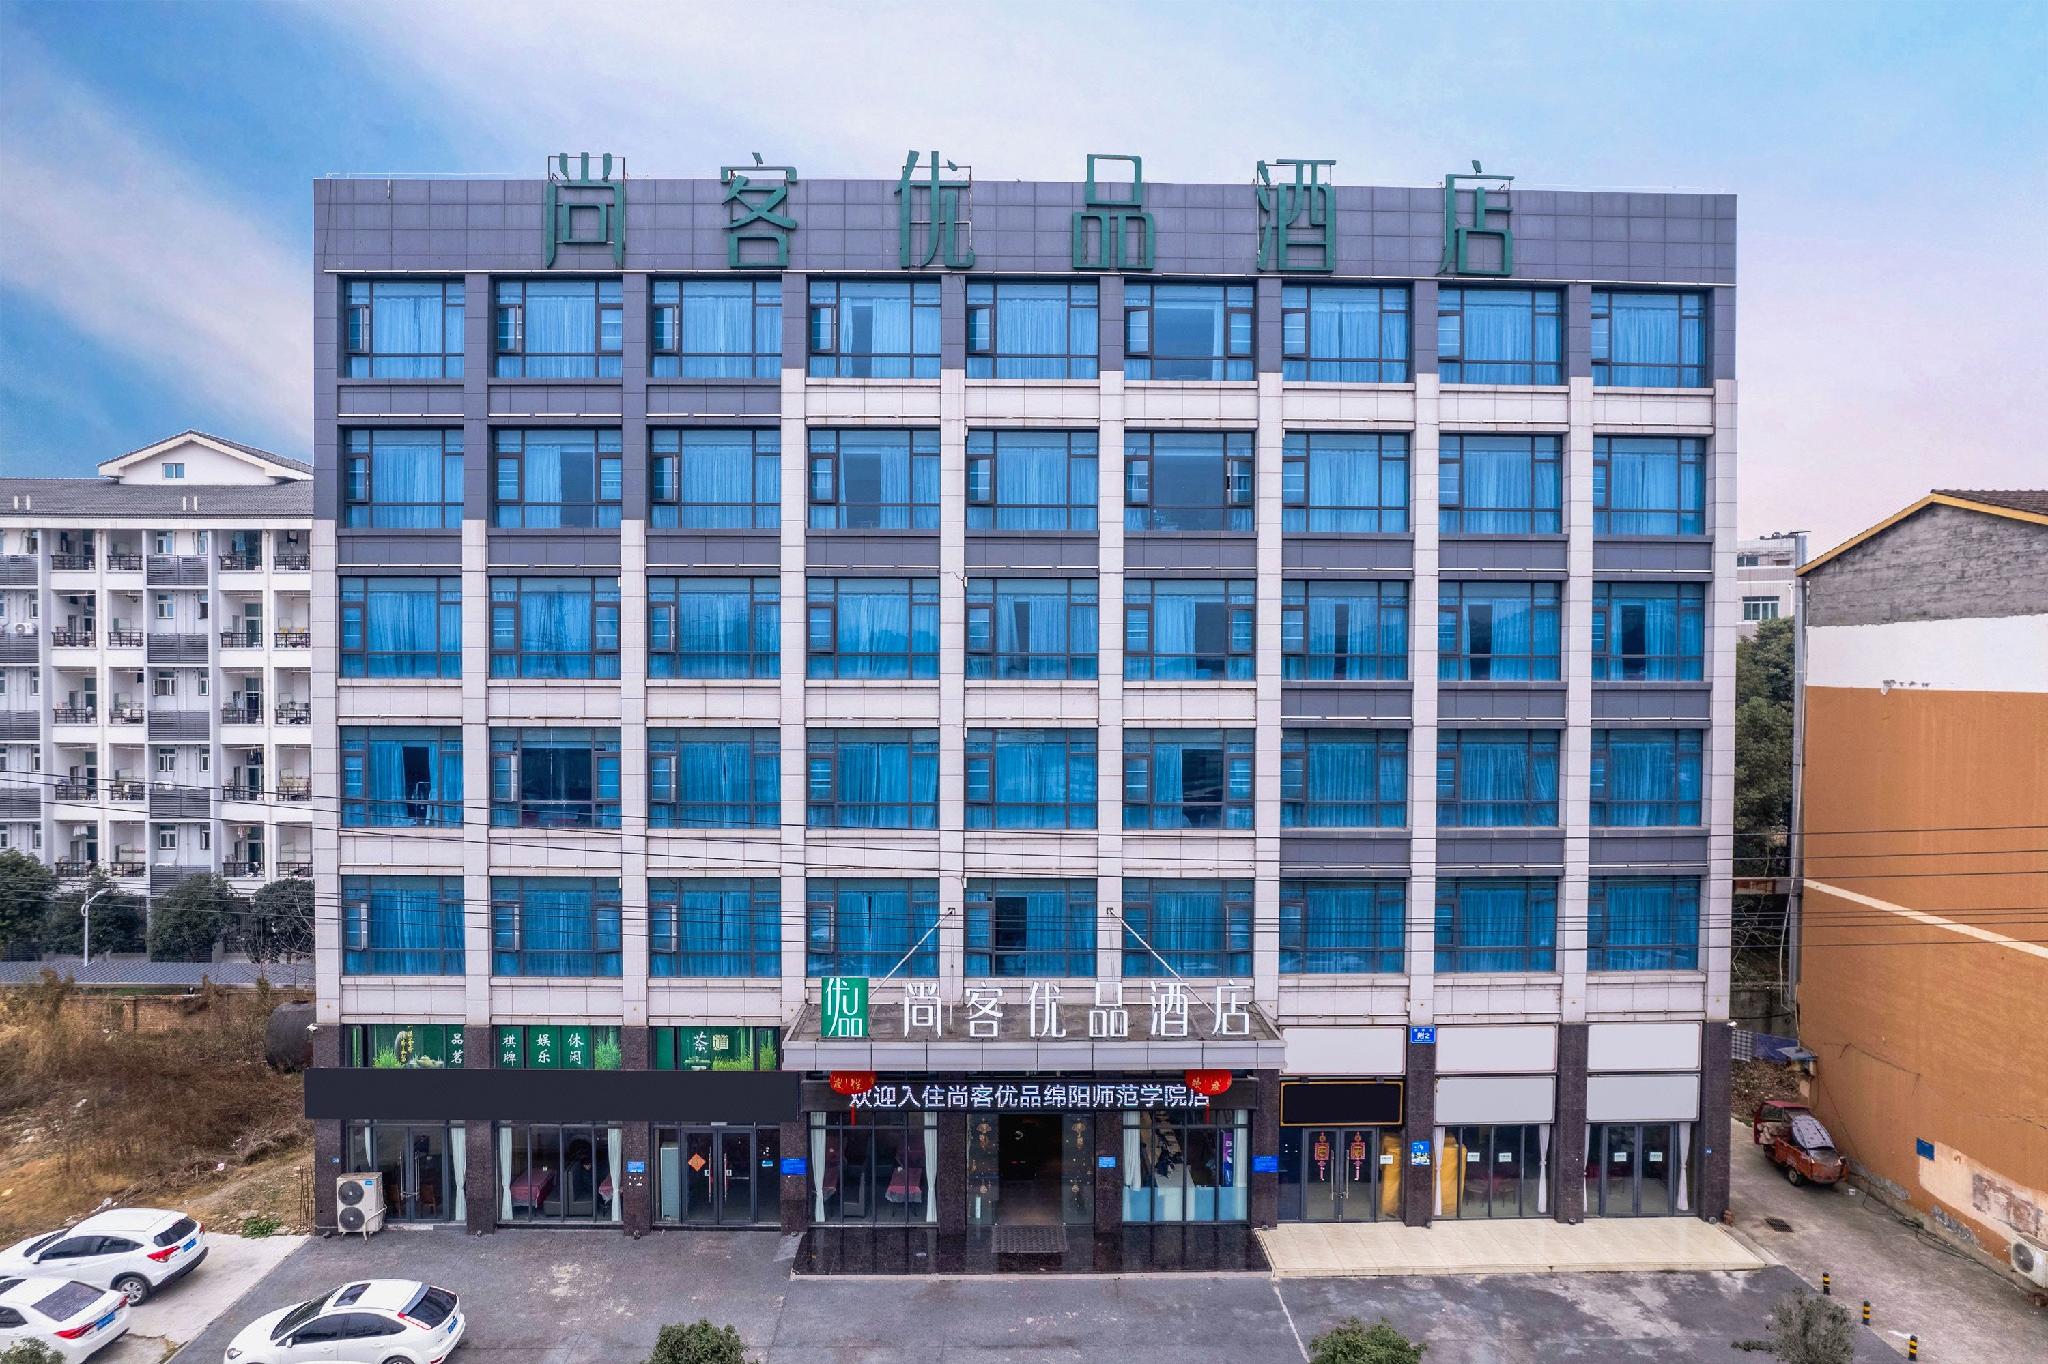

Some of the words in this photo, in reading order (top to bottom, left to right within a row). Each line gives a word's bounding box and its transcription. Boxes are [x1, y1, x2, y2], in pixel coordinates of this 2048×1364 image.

[546, 150, 1515, 277] 尚客优品酒店
[904, 979, 1250, 1039] 尚客优品酒店
[451, 1033, 464, 1064] 品茗
[502, 1034, 517, 1066] 棋牌
[536, 1034, 551, 1063] 娱乐
[568, 1033, 584, 1064] 休闲
[849, 1083, 1210, 1109] 欢迎入住尚客优品绵阳师范学院店
